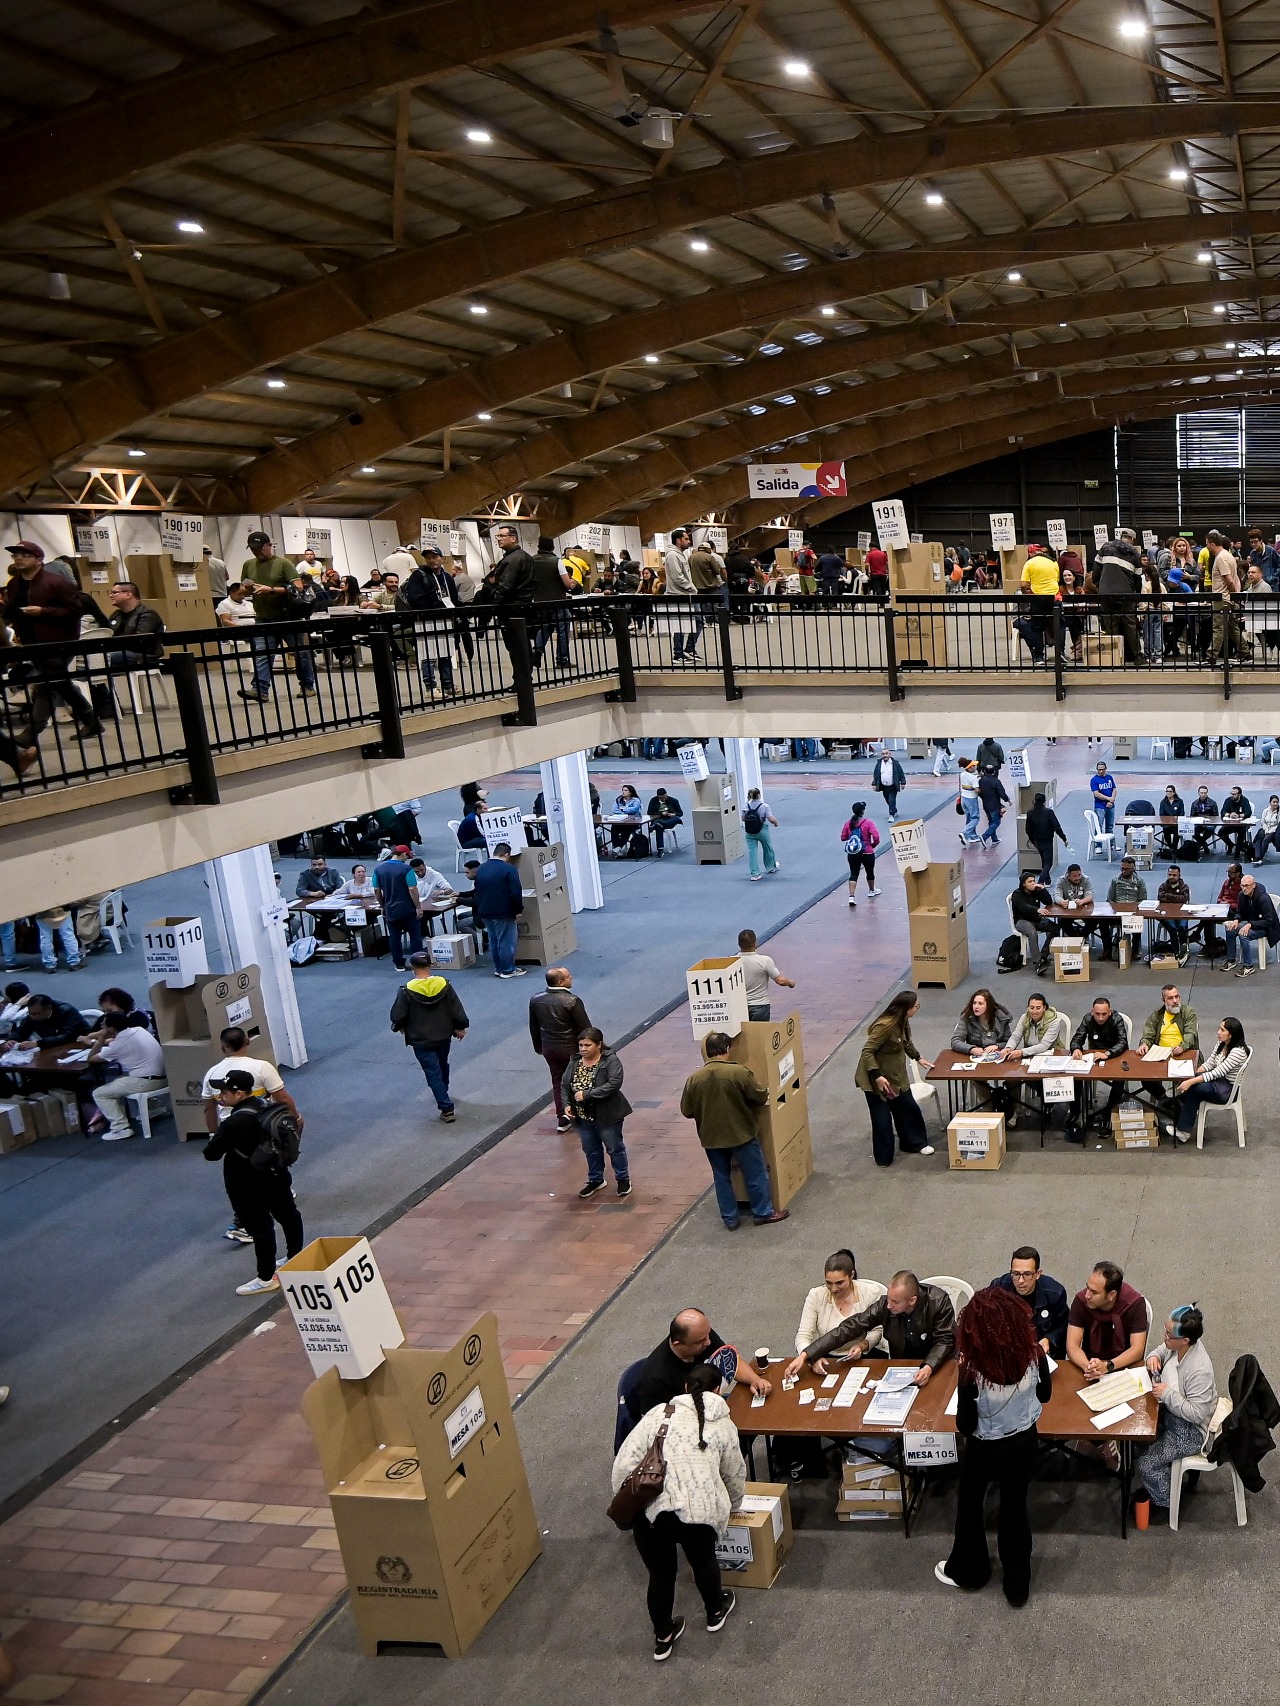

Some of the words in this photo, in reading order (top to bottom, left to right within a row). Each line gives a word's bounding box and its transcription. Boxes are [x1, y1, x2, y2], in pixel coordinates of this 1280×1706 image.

[757, 478, 799, 490] Salida
[876, 506, 896, 519] 191
[164, 519, 182, 532] 190
[185, 521, 202, 532] 190
[992, 518, 1007, 527] 197
[1049, 523, 1062, 531] 203
[423, 523, 437, 532] 196
[439, 524, 449, 533] 196
[589, 526, 601, 535] 202
[94, 531, 109, 540] 195
[680, 751, 695, 760] 122
[1009, 756, 1023, 765] 123
[485, 816, 507, 829] 116
[509, 812, 521, 827] 116
[892, 829, 913, 844] 117
[267, 908, 283, 916] SALIDA
[145, 933, 176, 948] 110
[179, 926, 202, 946] 110
[691, 977, 724, 995] 111
[729, 967, 743, 990] 111
[230, 1013, 242, 1023] MESA
[242, 1009, 252, 1018] 110
[287, 1284, 332, 1310] 105
[333, 1253, 375, 1303] 105
[299, 1324, 341, 1332] 53.036.604
[306, 1344, 348, 1352] 53.047.537
[451, 1425, 469, 1448] MESA
[470, 1409, 483, 1427] 105
[936, 1451, 954, 1459] 105
[730, 1546, 749, 1554] 105
[357, 1586, 438, 1595] REGISTRADURÍA
